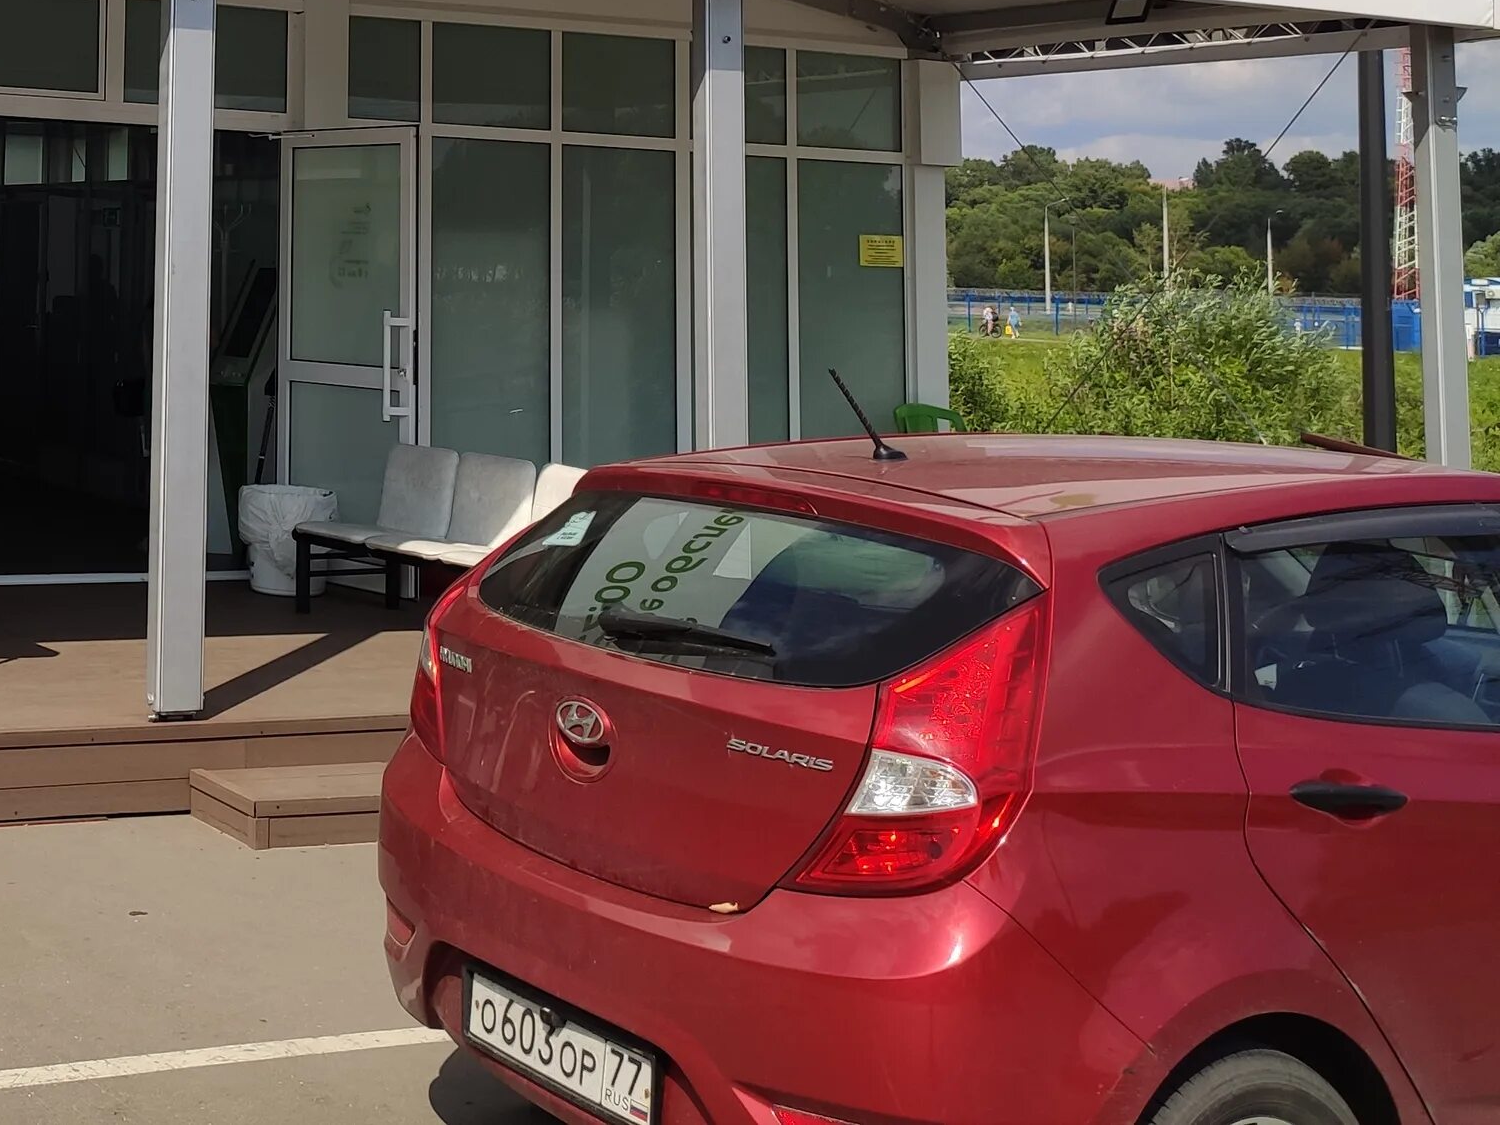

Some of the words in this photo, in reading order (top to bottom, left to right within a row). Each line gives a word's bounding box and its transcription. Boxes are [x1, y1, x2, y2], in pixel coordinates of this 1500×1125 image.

[726, 738, 834, 772] SOLARIS
[610, 1048, 642, 1096] 77
[604, 1088, 630, 1112] RUS
